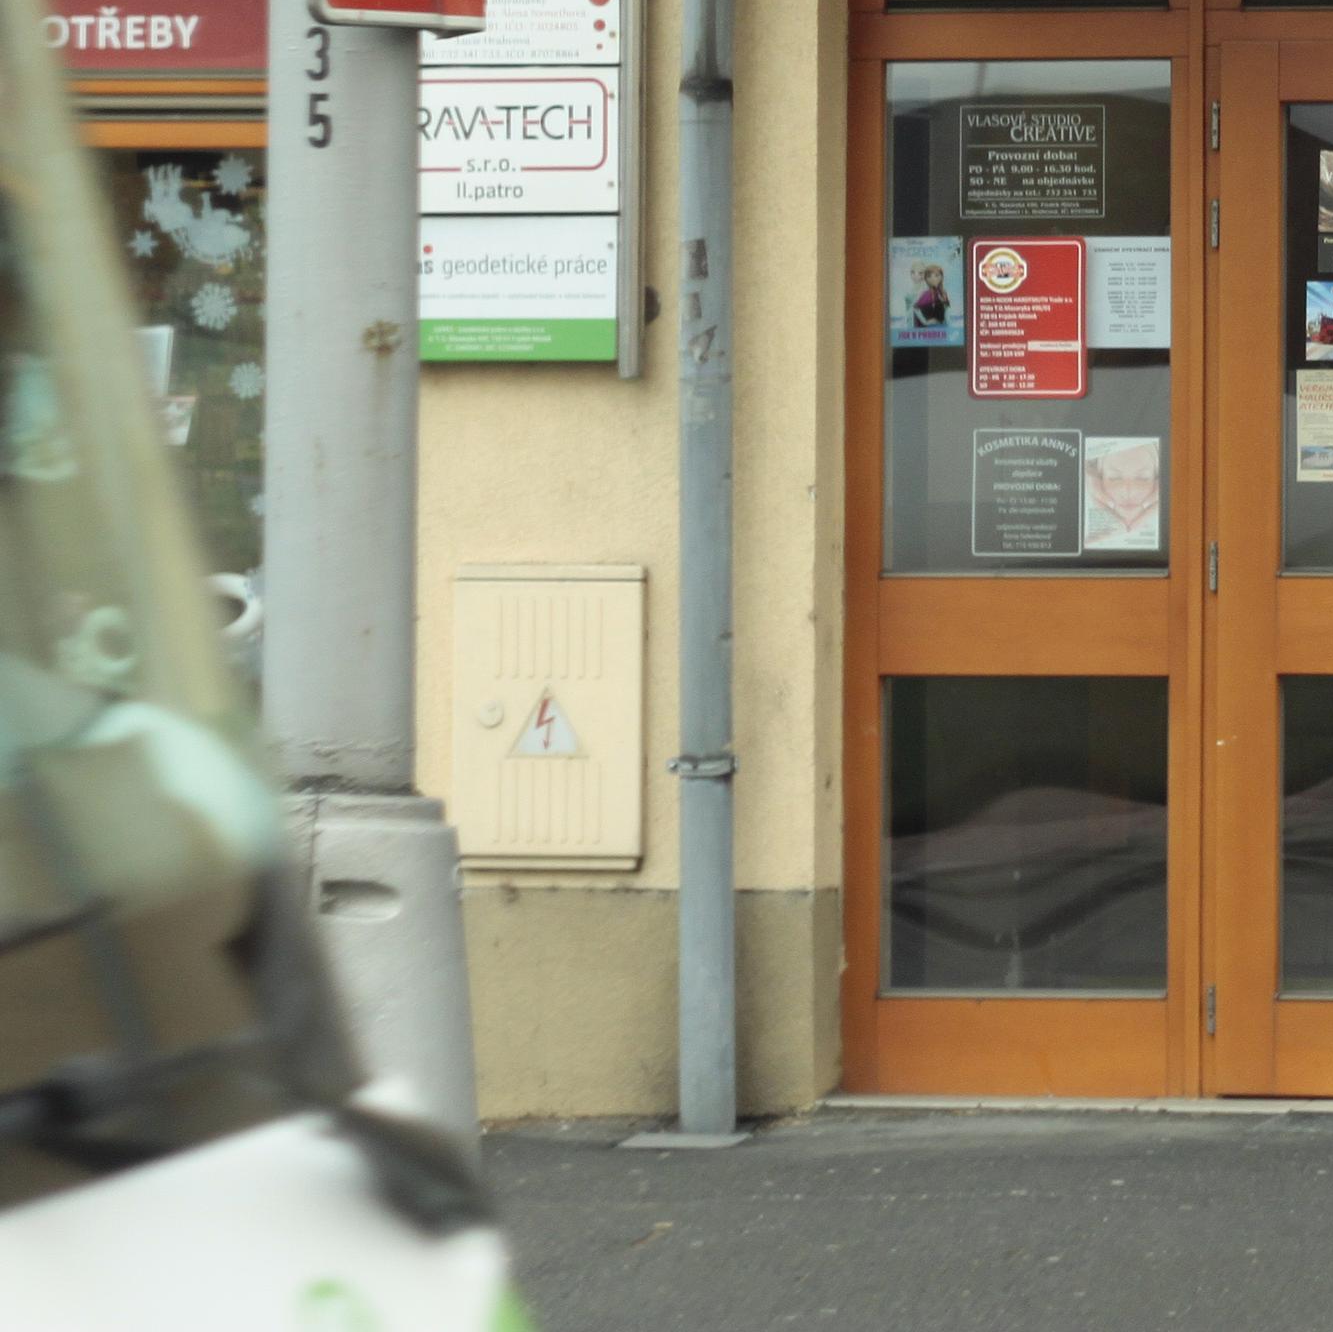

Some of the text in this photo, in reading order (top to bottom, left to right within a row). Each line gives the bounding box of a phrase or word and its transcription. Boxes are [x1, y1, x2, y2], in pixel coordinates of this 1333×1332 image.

[41, 6, 200, 51] OTŘEBY
[418, 104, 592, 141] RAVA-TECH
[967, 111, 1082, 128] VLASOVÉ STUDIO
[1010, 125, 1097, 143] CREATIVE
[988, 150, 1040, 161] Provozní
[466, 158, 516, 173] s.r.o.
[1074, 164, 1097, 174] hod.
[442, 254, 548, 280] geodetické
[554, 255, 608, 280] práce
[977, 435, 1078, 458] KOSMETIKA ANNYS
